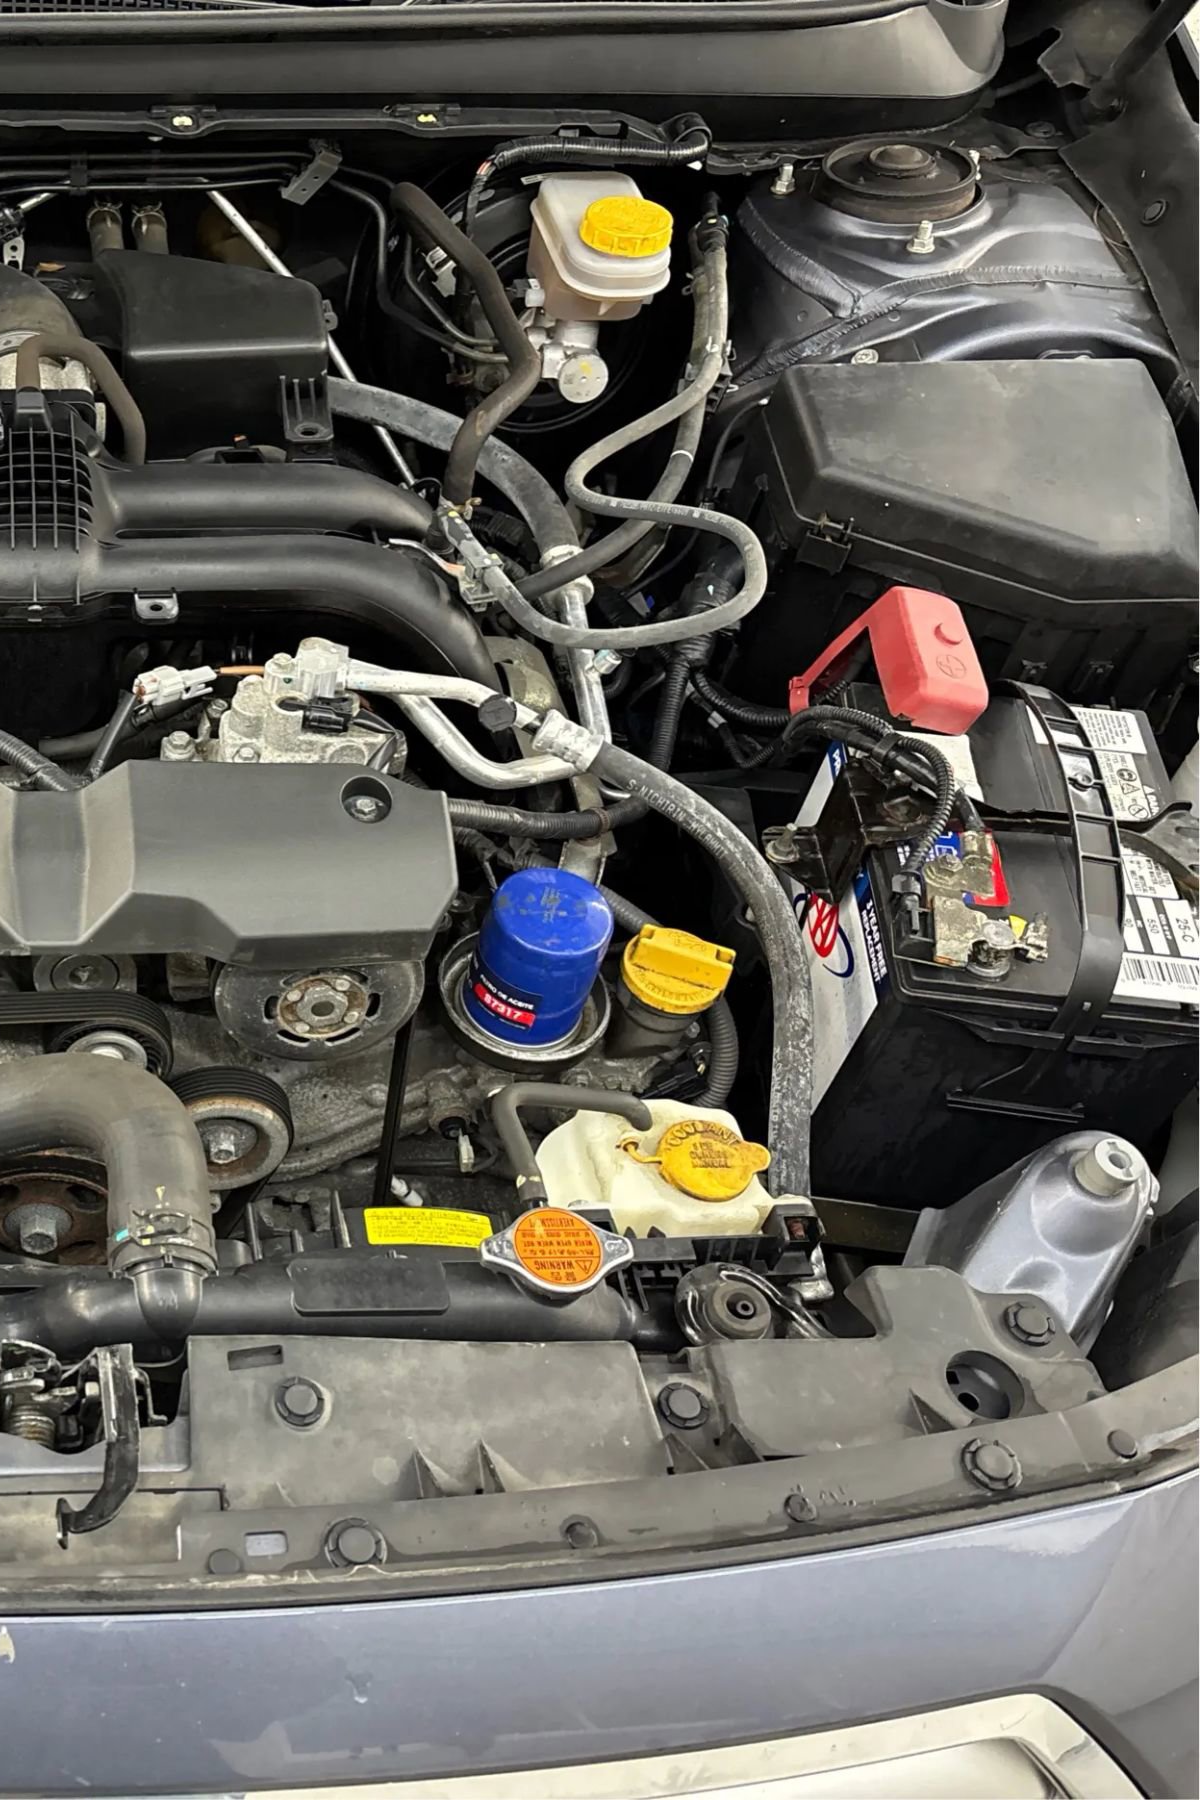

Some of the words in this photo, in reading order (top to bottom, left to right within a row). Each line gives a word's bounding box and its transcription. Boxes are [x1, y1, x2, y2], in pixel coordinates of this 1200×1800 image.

[868, 907, 881, 945] YEAR
[874, 941, 888, 979] FREE
[535, 1260, 576, 1271] WARNING
